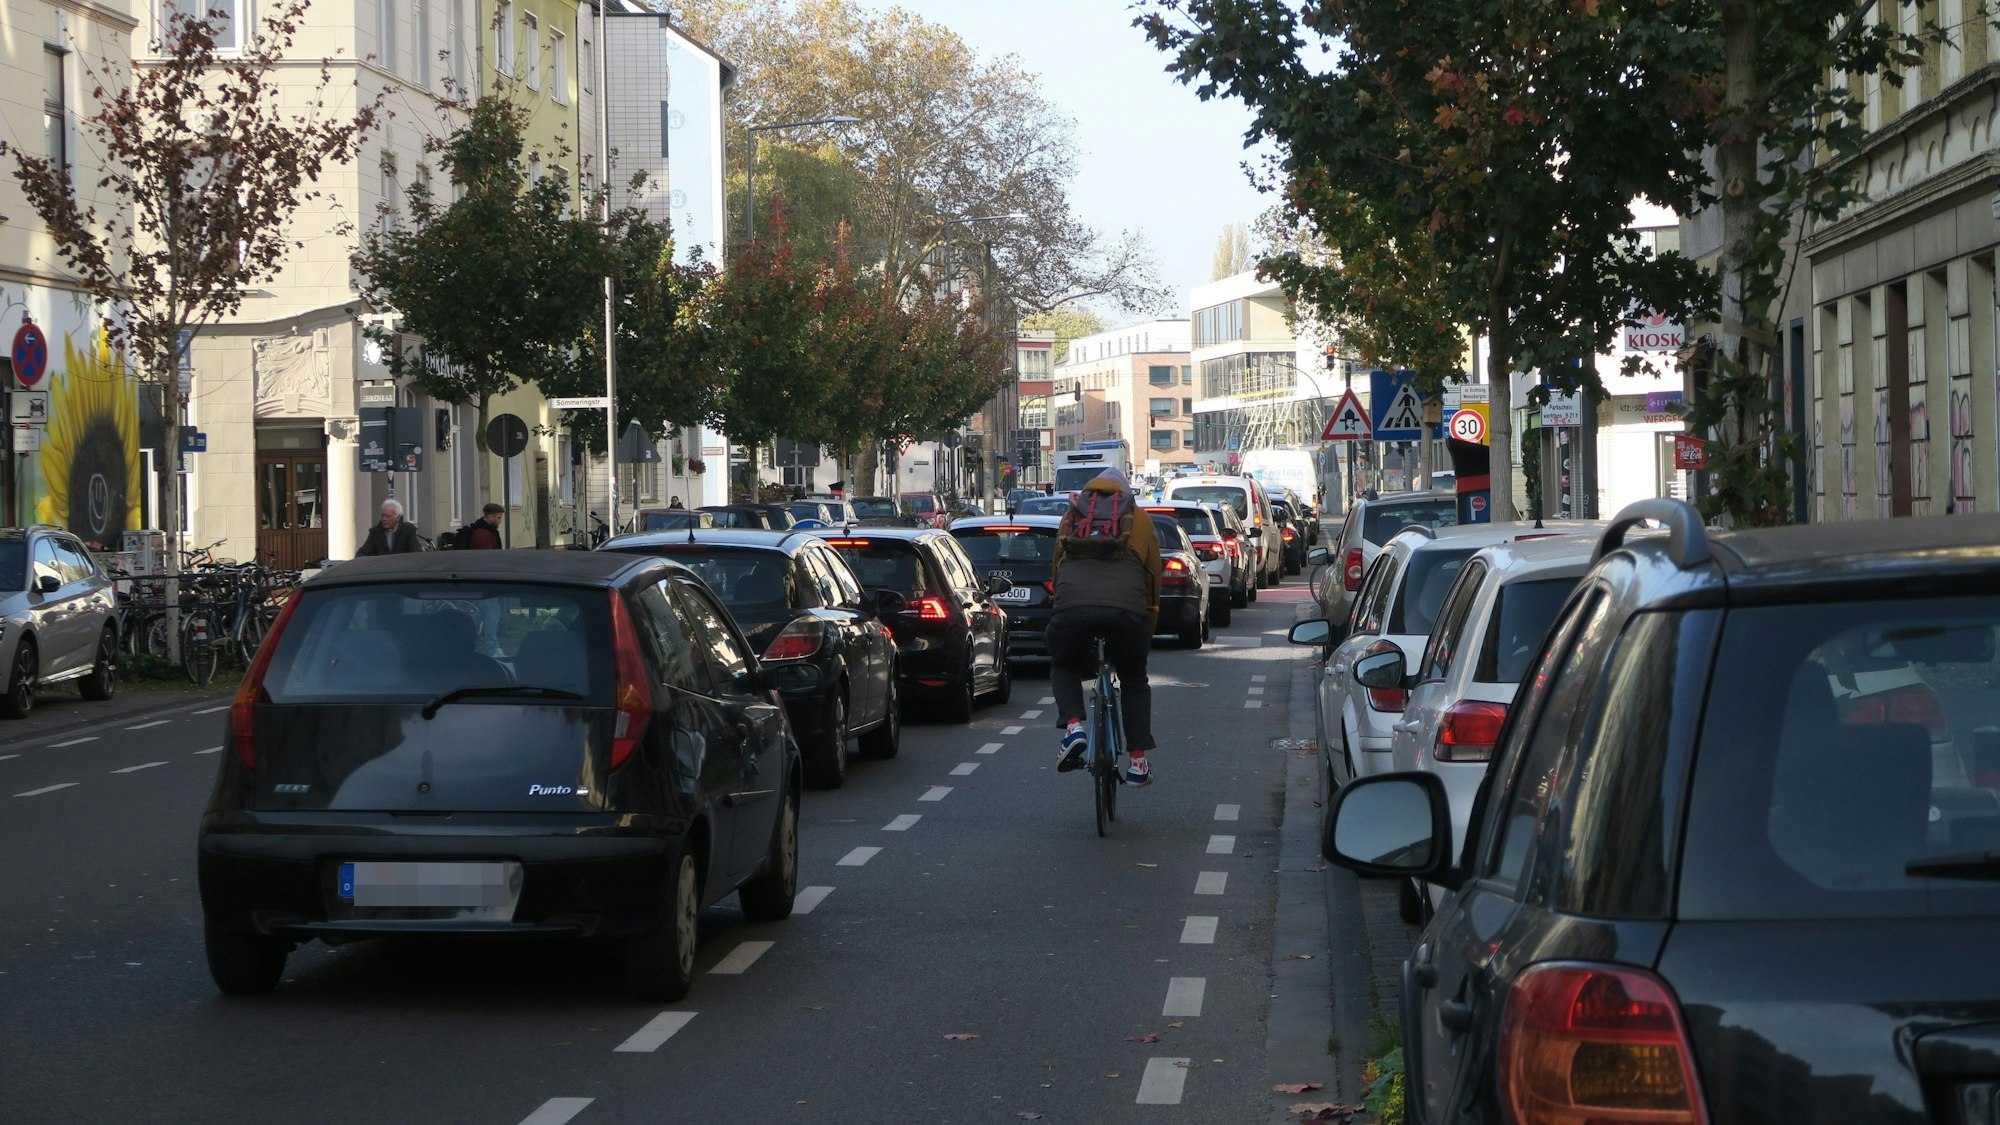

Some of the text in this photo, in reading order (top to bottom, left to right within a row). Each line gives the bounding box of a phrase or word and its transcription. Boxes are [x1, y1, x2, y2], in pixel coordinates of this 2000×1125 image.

[1628, 332, 1681, 348] KIOSK
[1457, 419, 1478, 435] 30
[528, 784, 571, 796] Punto
